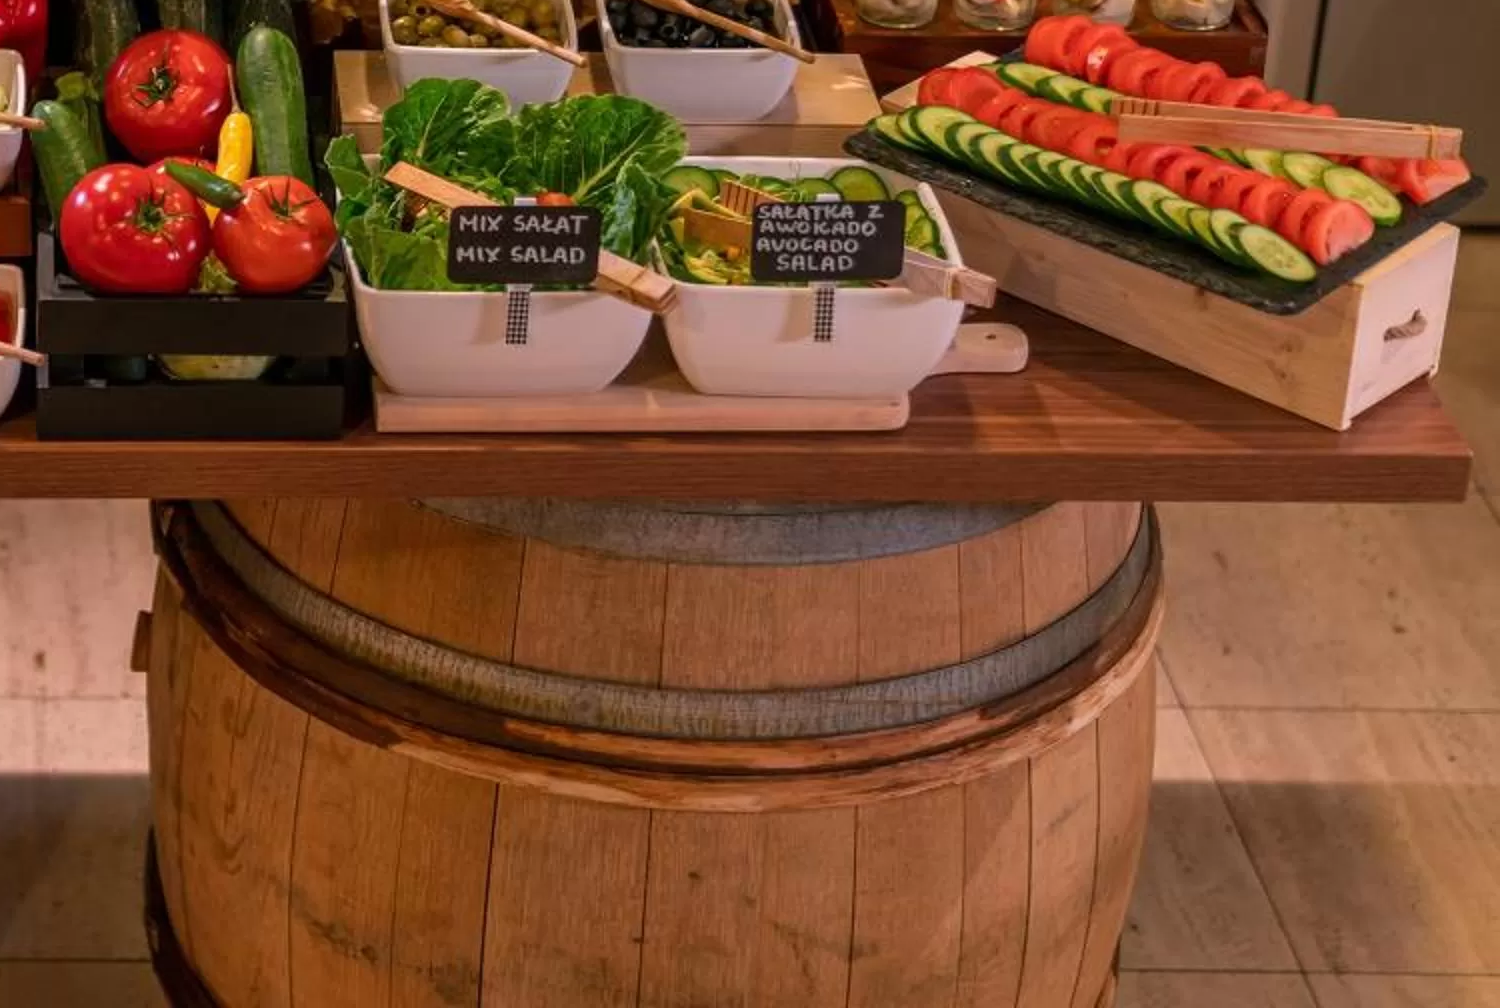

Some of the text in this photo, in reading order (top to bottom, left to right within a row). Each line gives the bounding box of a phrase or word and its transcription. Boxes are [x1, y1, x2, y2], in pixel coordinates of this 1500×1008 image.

[757, 204, 885, 220] SAŁATKA Z
[458, 214, 589, 235] MIX SAŁAT
[759, 220, 877, 237] AWOKADO
[756, 237, 860, 254] AVOCADO
[456, 245, 586, 264] MIX SALAD
[776, 254, 854, 272] SALAD
